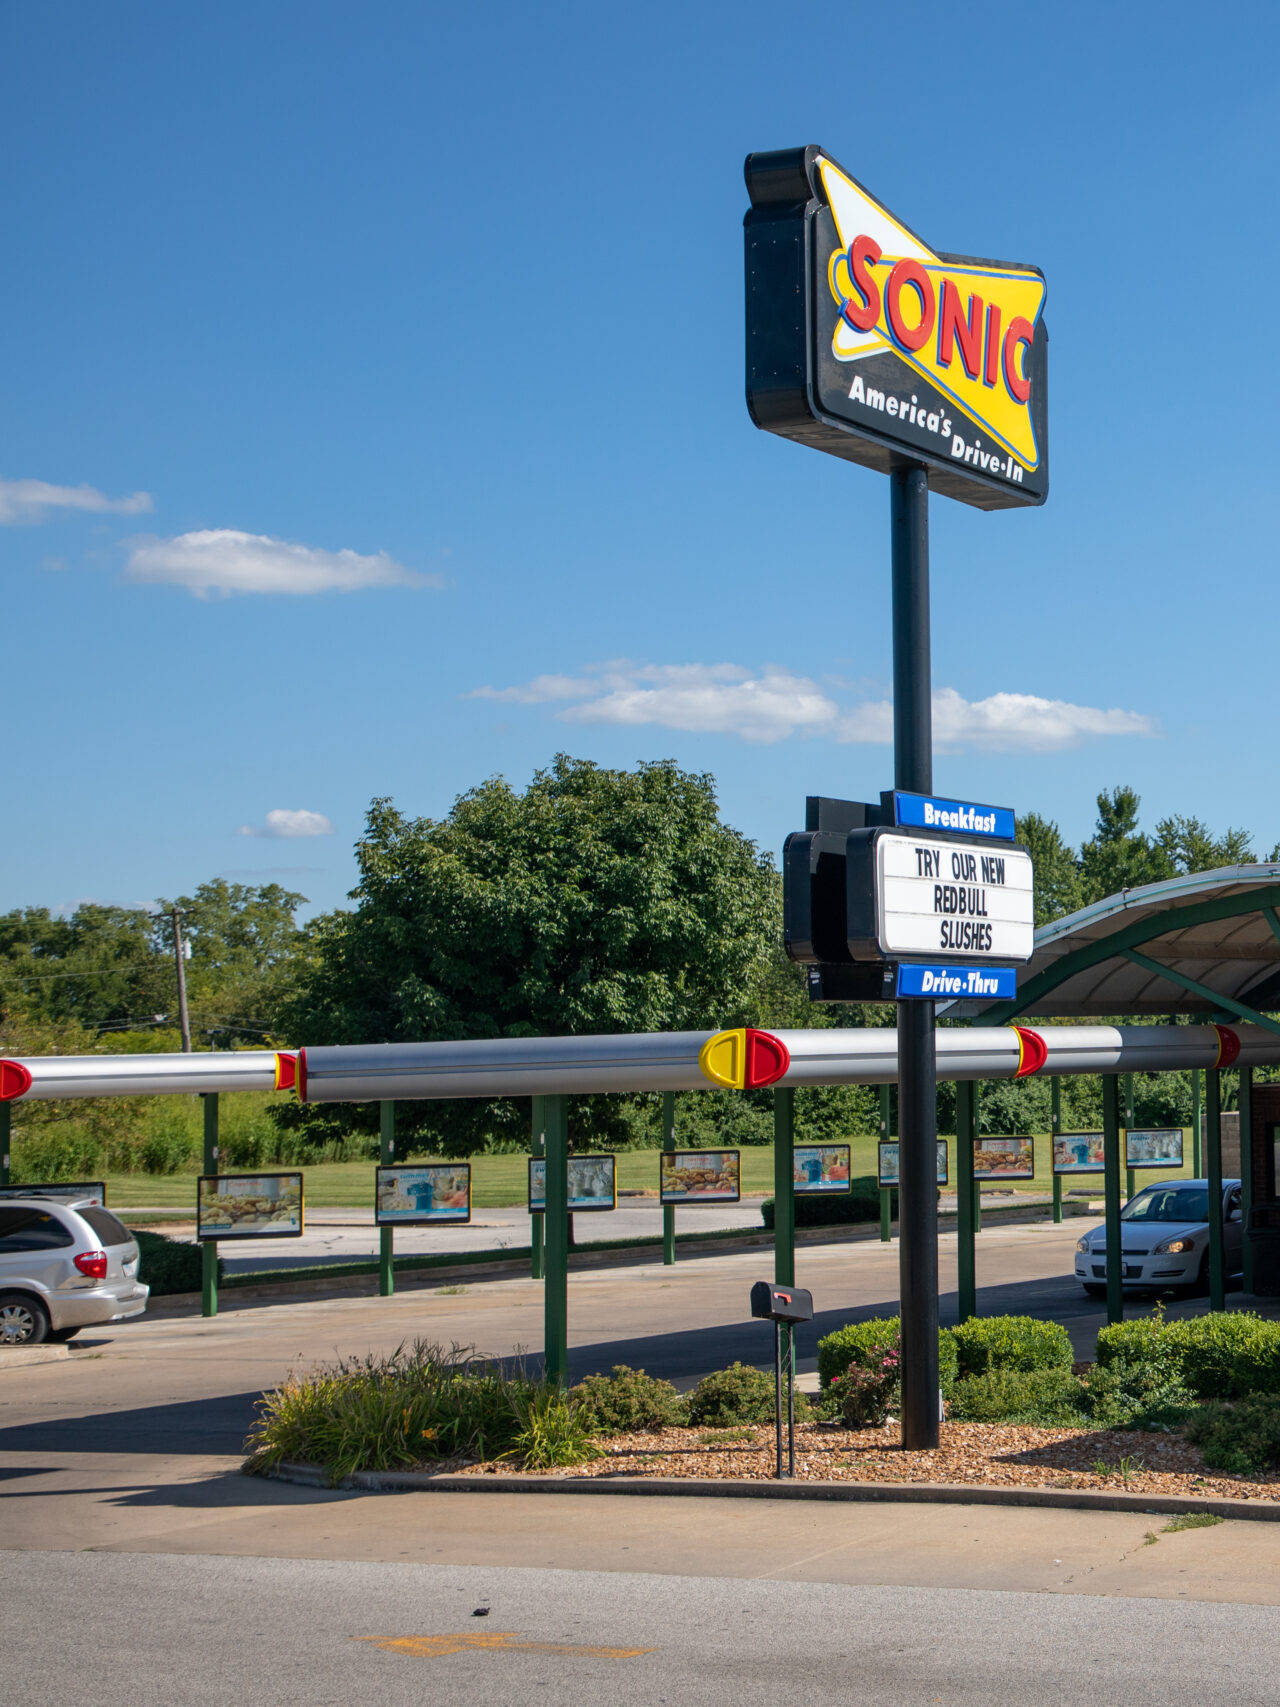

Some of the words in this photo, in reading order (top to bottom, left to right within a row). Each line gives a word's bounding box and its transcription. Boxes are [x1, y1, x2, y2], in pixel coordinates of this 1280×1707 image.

[839, 234, 1034, 405] SONIC
[848, 375, 952, 437] America's
[924, 803, 996, 833] Breakfast
[915, 848, 940, 877] TRY
[952, 852, 977, 881] OUR
[980, 855, 1005, 884] NEW
[934, 885, 988, 917] REDBULL
[940, 920, 992, 951] SLUSHES
